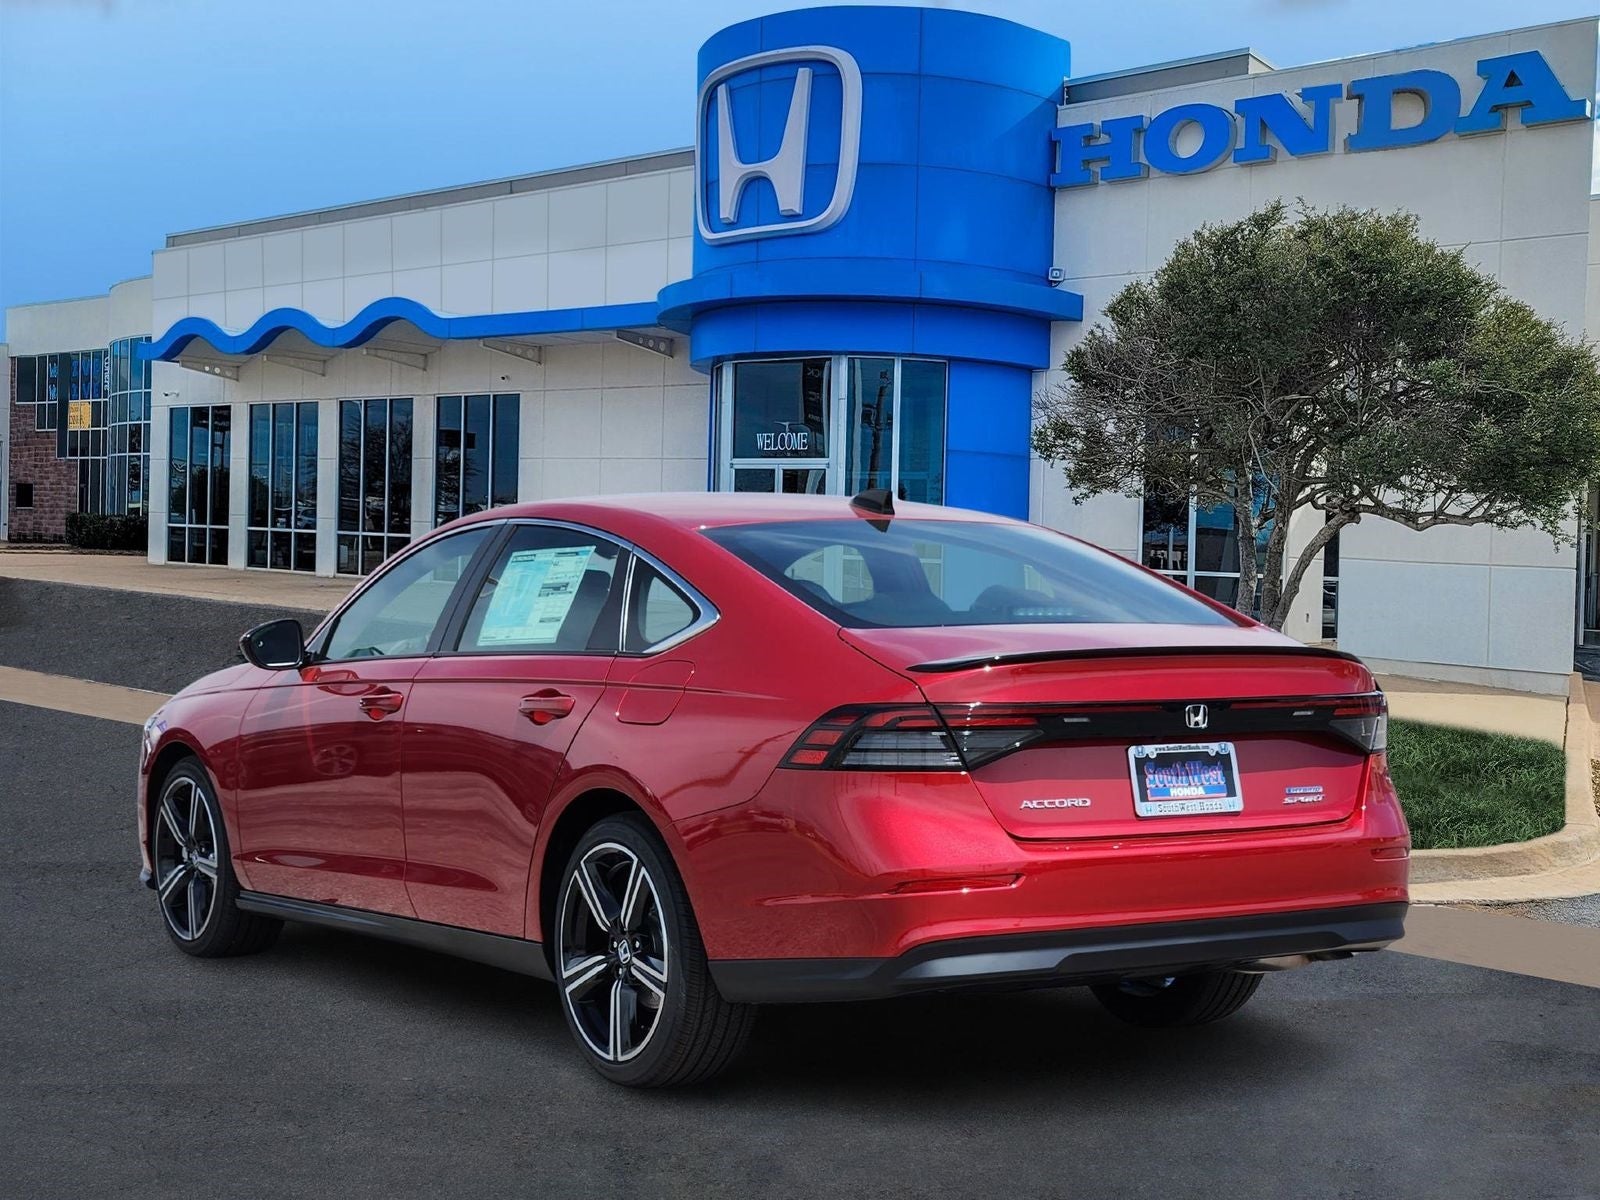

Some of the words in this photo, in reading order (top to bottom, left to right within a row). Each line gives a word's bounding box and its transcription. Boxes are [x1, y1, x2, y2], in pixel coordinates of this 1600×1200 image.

[1050, 51, 1590, 188] HONDA
[756, 432, 808, 450] WELCOME
[1170, 786, 1205, 797] HONDA
[1020, 798, 1091, 809] ACCORD
